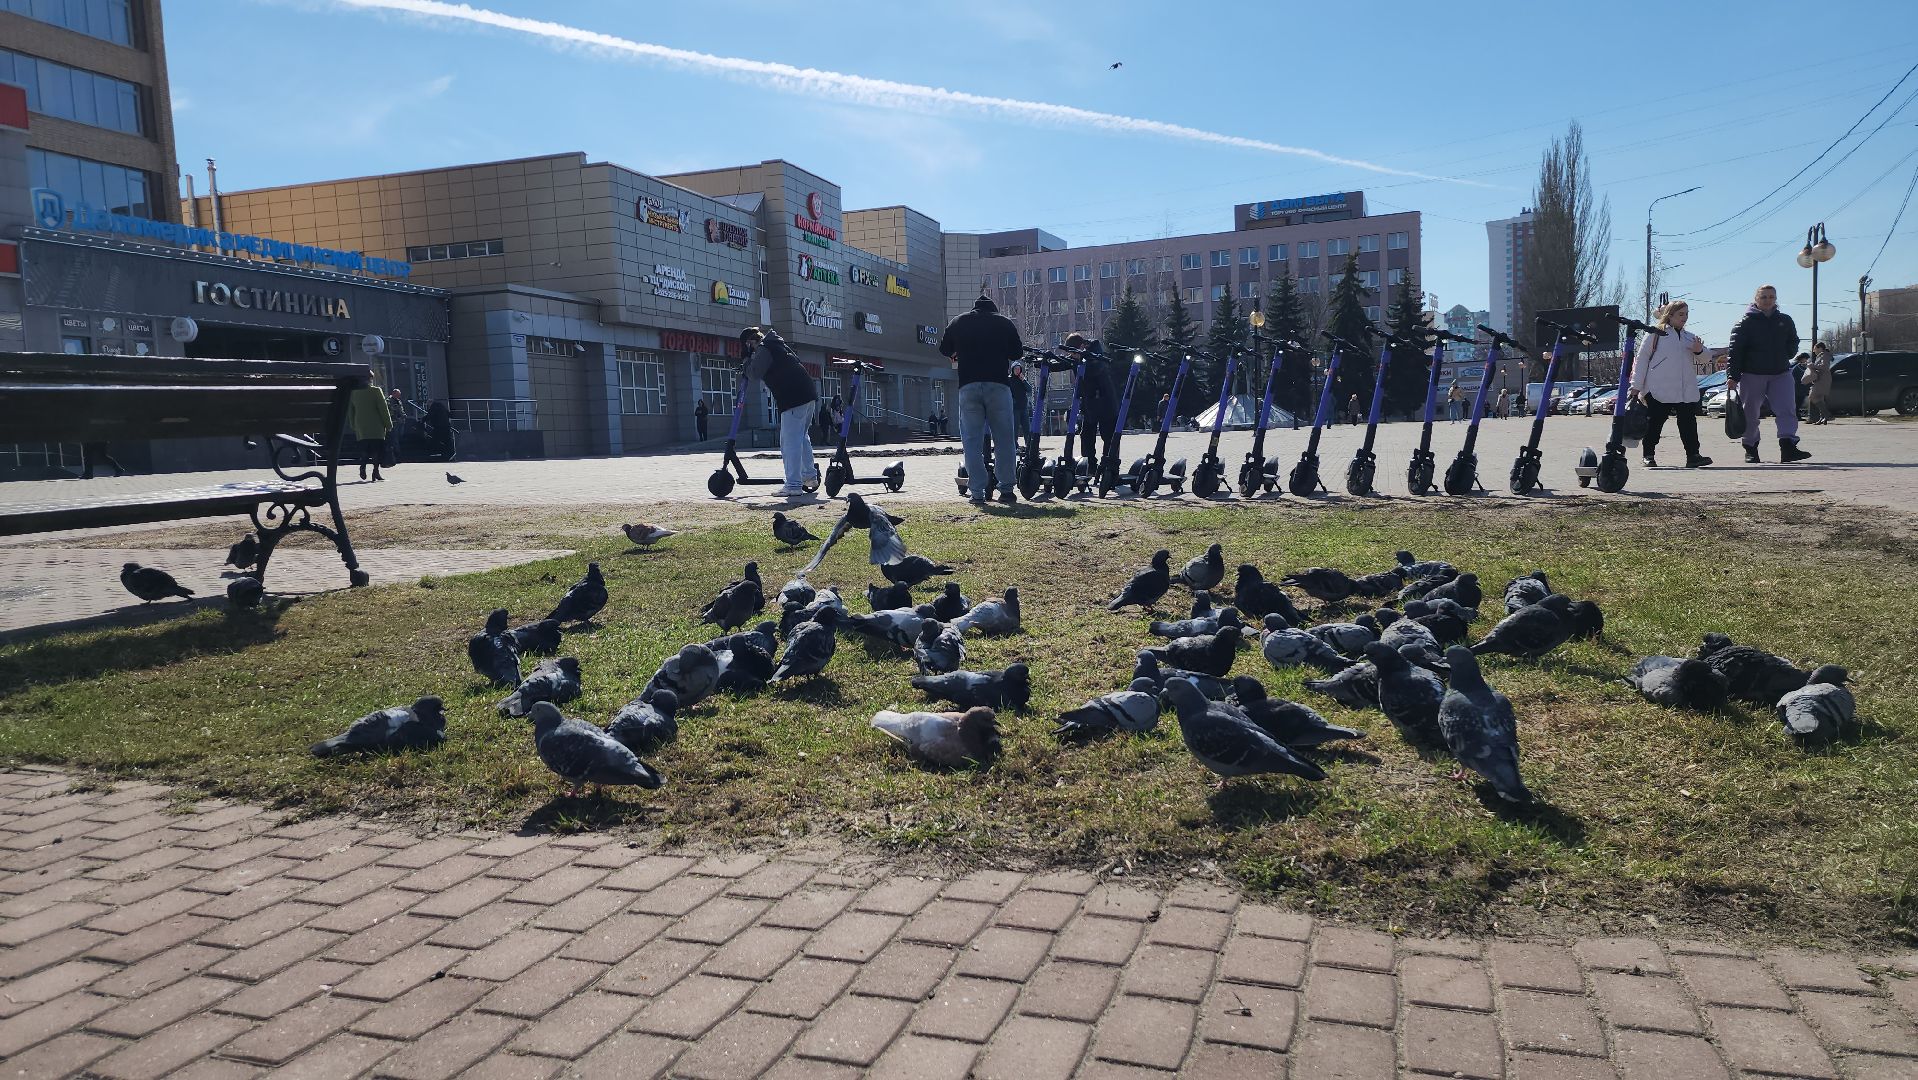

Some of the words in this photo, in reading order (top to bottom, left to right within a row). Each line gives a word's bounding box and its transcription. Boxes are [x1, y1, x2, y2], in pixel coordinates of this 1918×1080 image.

[655, 264, 687, 281] АРЕНДА
[813, 267, 841, 285] АПТЕКА
[193, 280, 351, 321] ГОСТИНИЦА
[63, 319, 87, 328] ЦВЕТЫ
[128, 324, 150, 332] ЦВЕТЫ
[661, 332, 721, 354] ТОРГОВЫЙ
